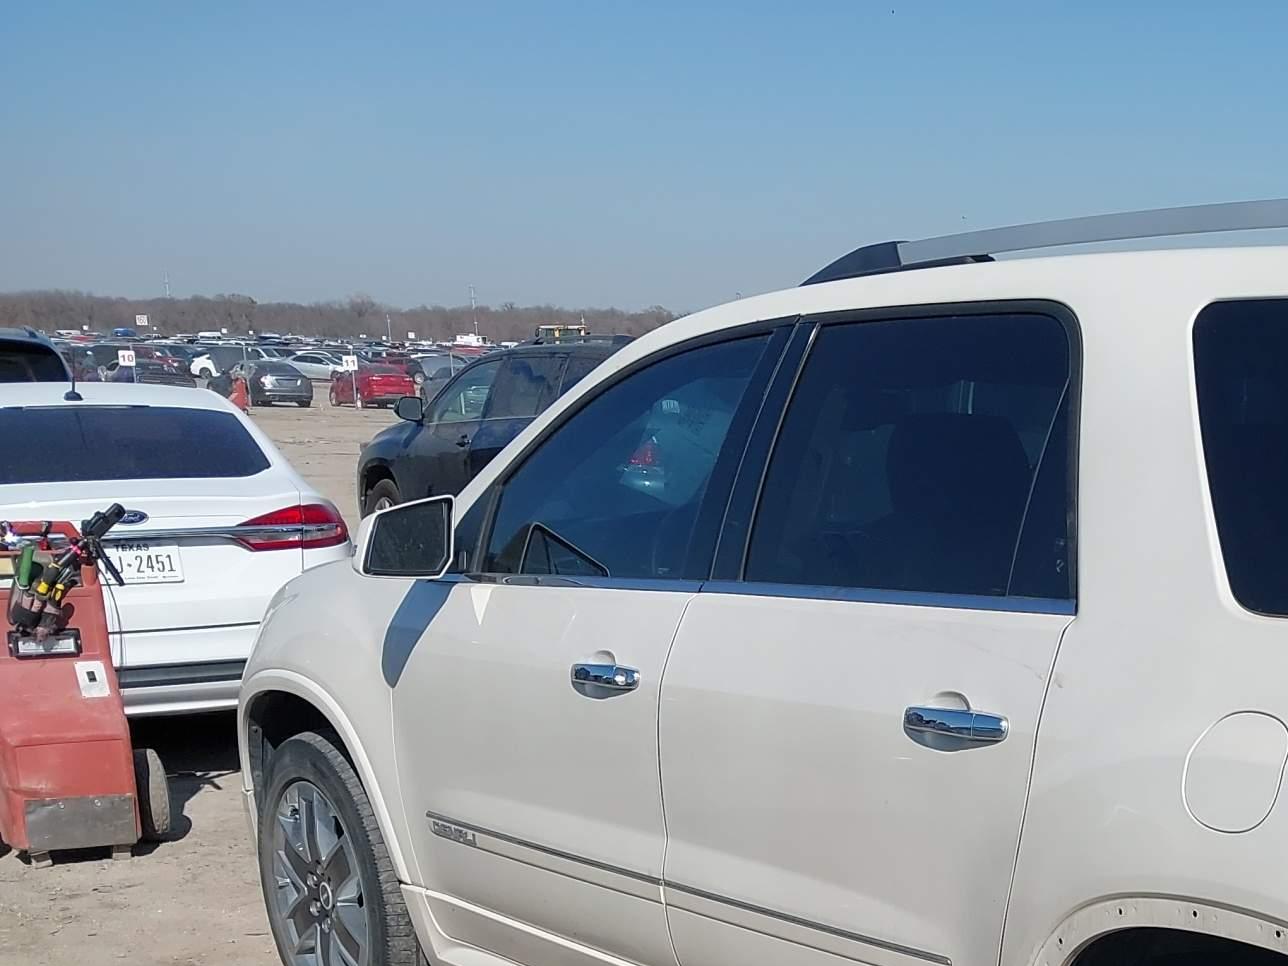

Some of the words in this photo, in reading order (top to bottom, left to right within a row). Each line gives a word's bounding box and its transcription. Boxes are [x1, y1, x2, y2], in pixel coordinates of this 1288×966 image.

[120, 354, 134, 363] 10
[345, 359, 356, 367] 11
[113, 543, 150, 552] TEXAS
